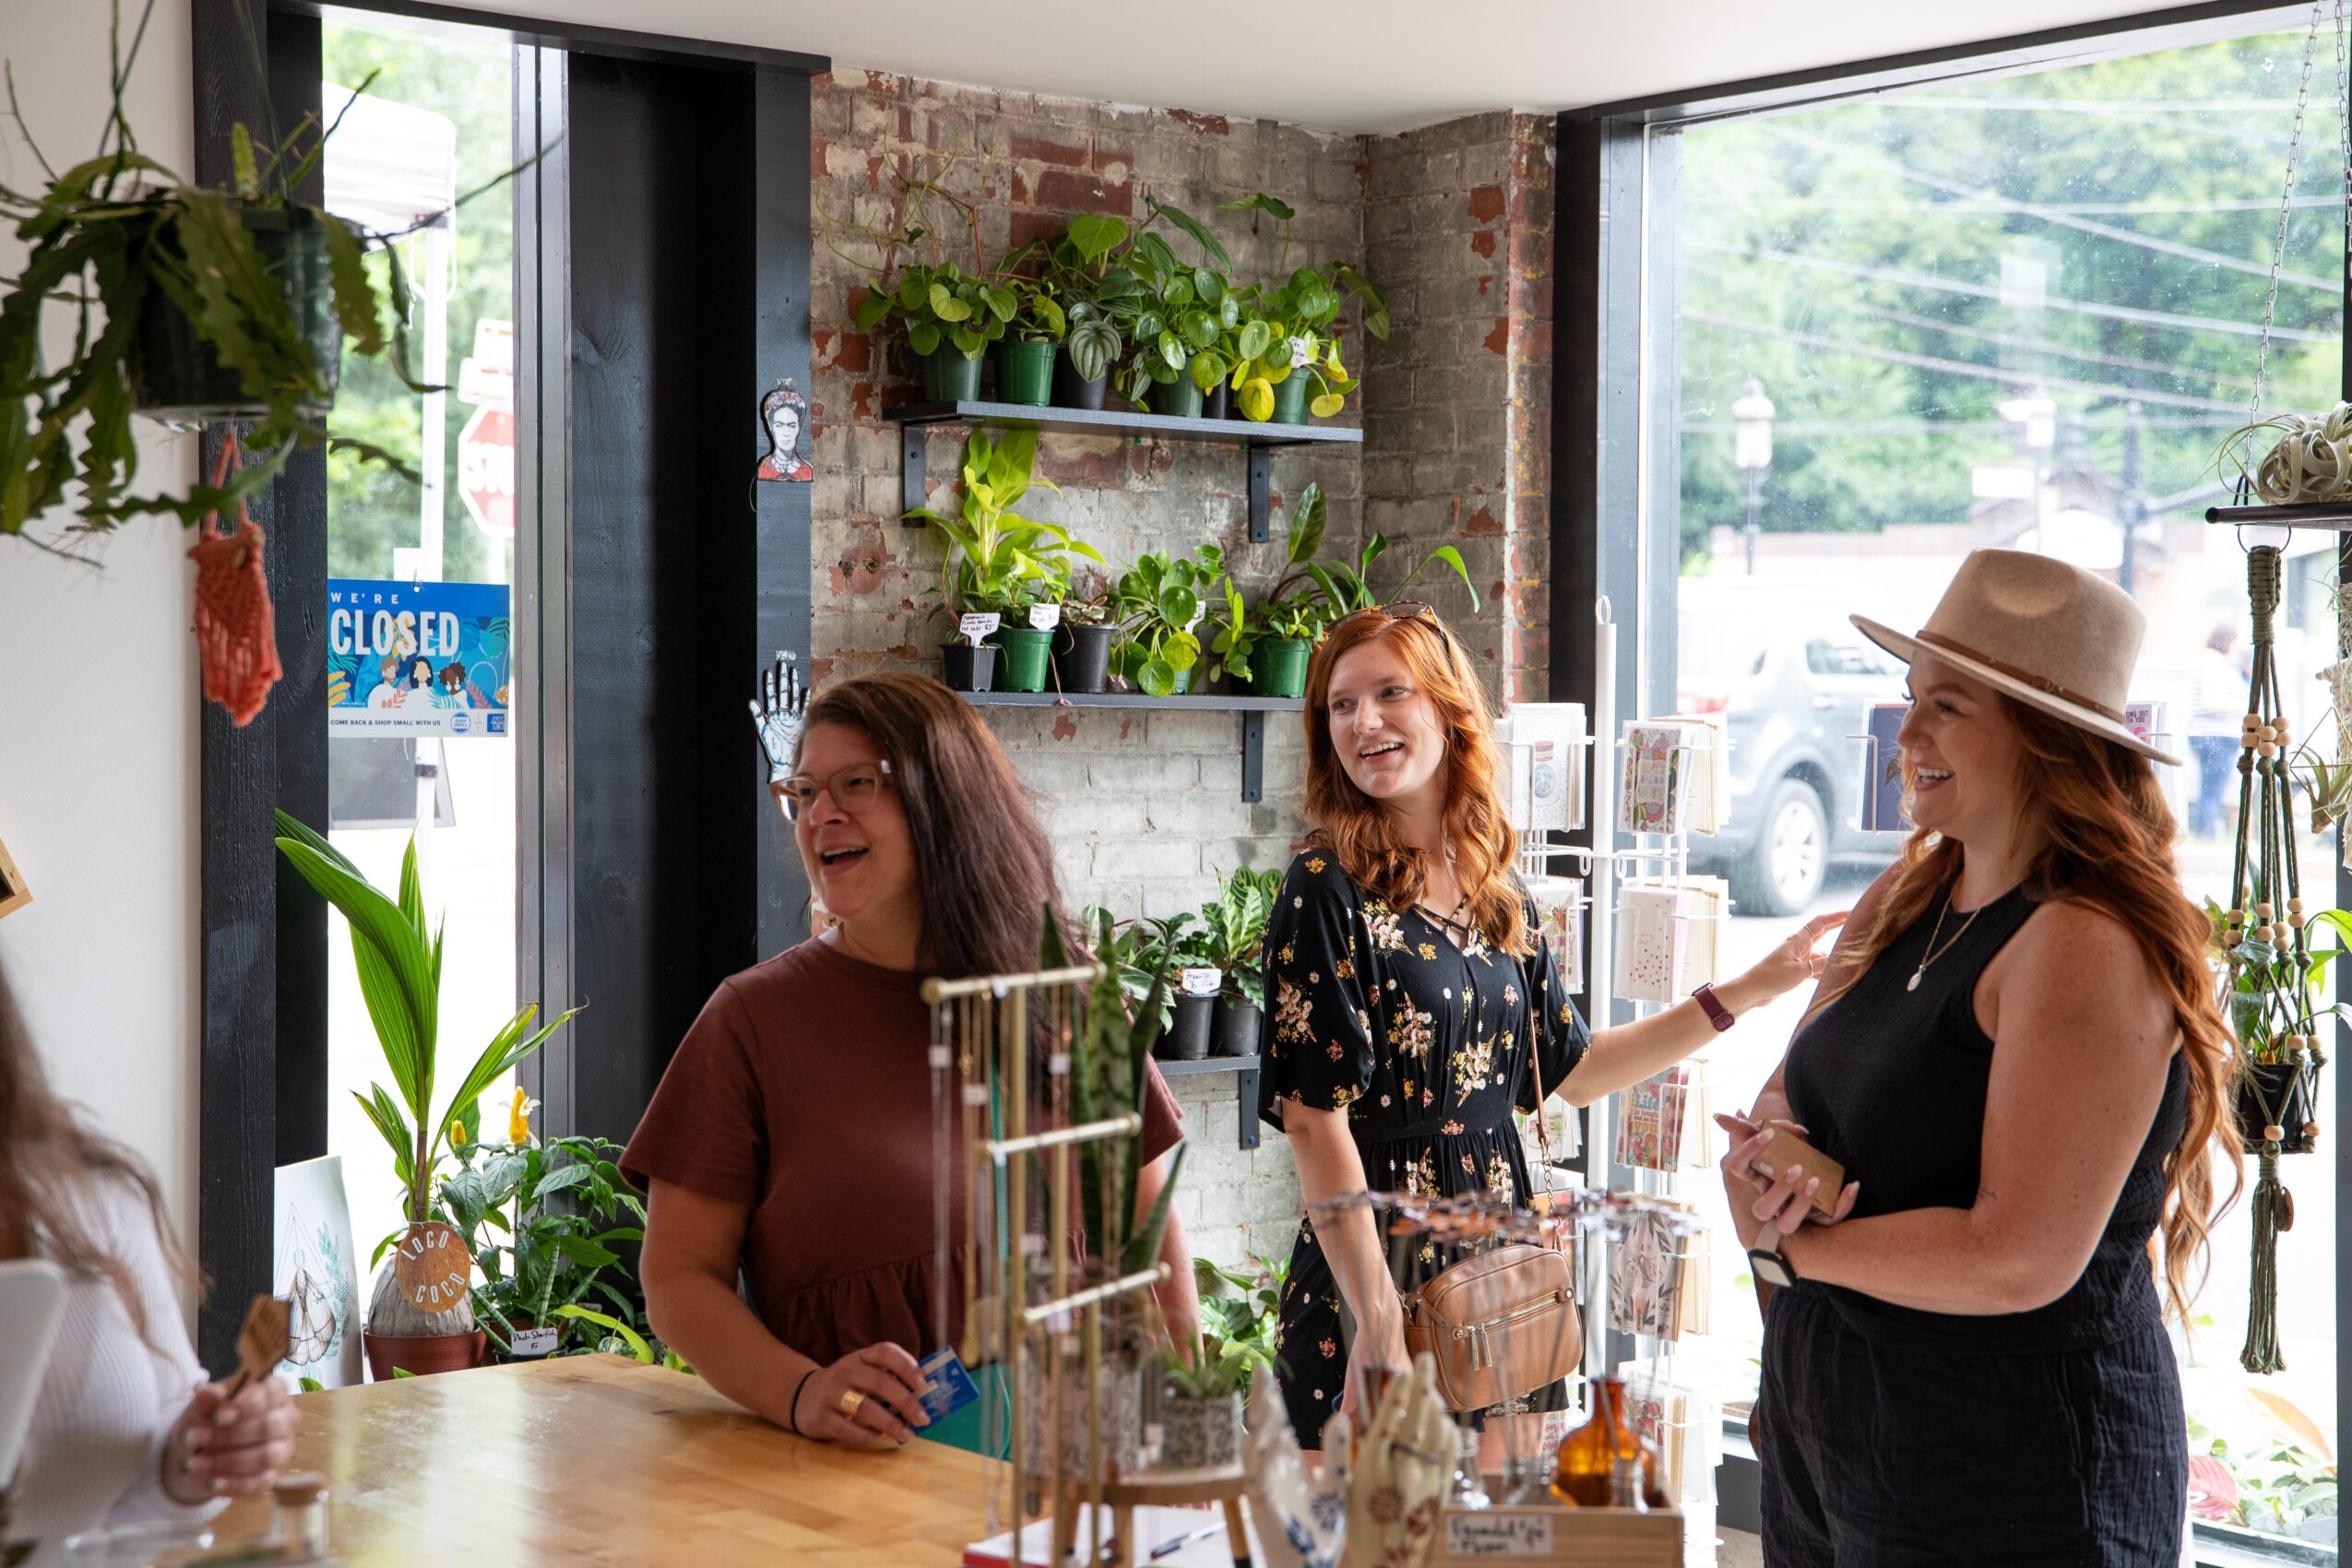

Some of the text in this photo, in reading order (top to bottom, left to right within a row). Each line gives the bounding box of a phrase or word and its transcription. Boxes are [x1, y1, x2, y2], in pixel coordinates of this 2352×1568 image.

[467, 440, 514, 494] STO
[330, 592, 399, 605] WE'RE
[330, 608, 459, 658] CLOSED
[401, 1230, 449, 1261] LOCO
[415, 1272, 466, 1303] COCO
